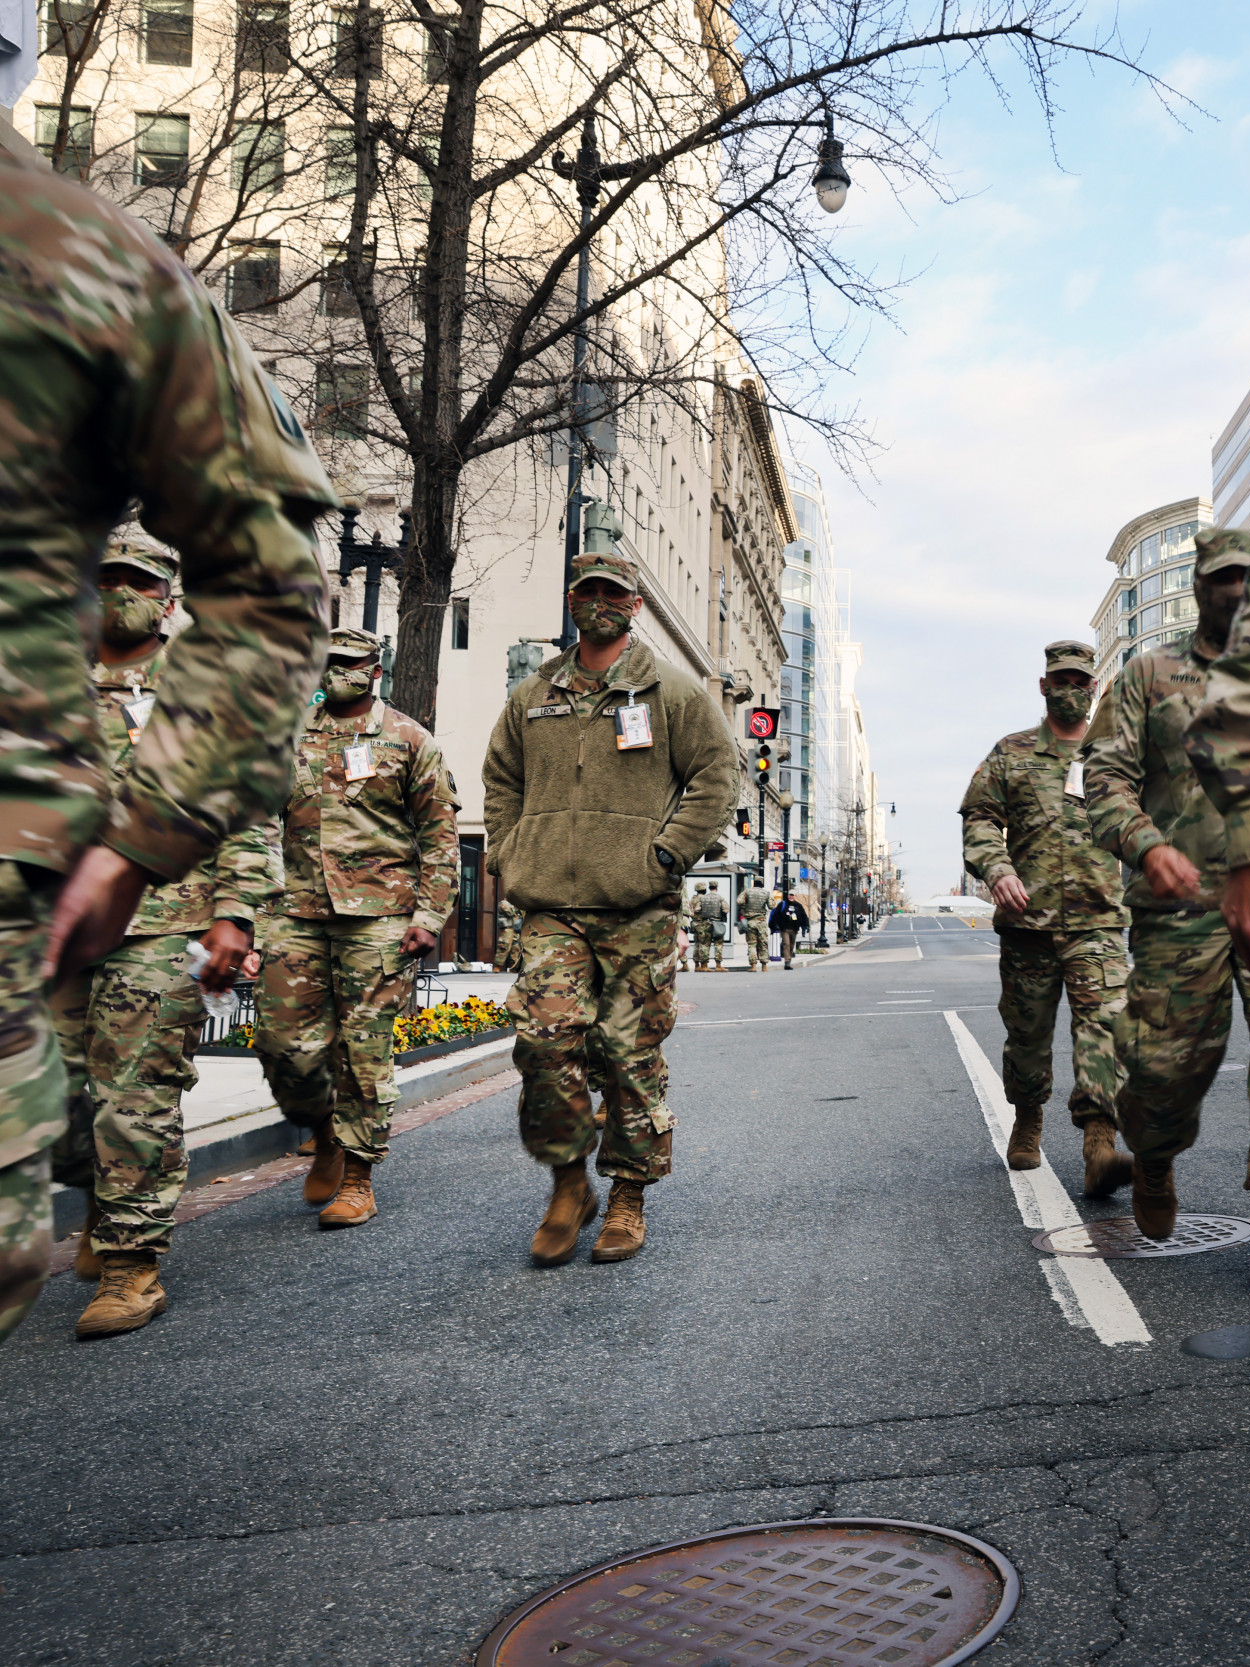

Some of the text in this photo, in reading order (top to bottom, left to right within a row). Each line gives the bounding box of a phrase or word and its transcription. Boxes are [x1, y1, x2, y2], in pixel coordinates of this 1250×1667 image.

[312, 691, 325, 704] G
[540, 707, 556, 716] LEON
[743, 823, 750, 835] 8
